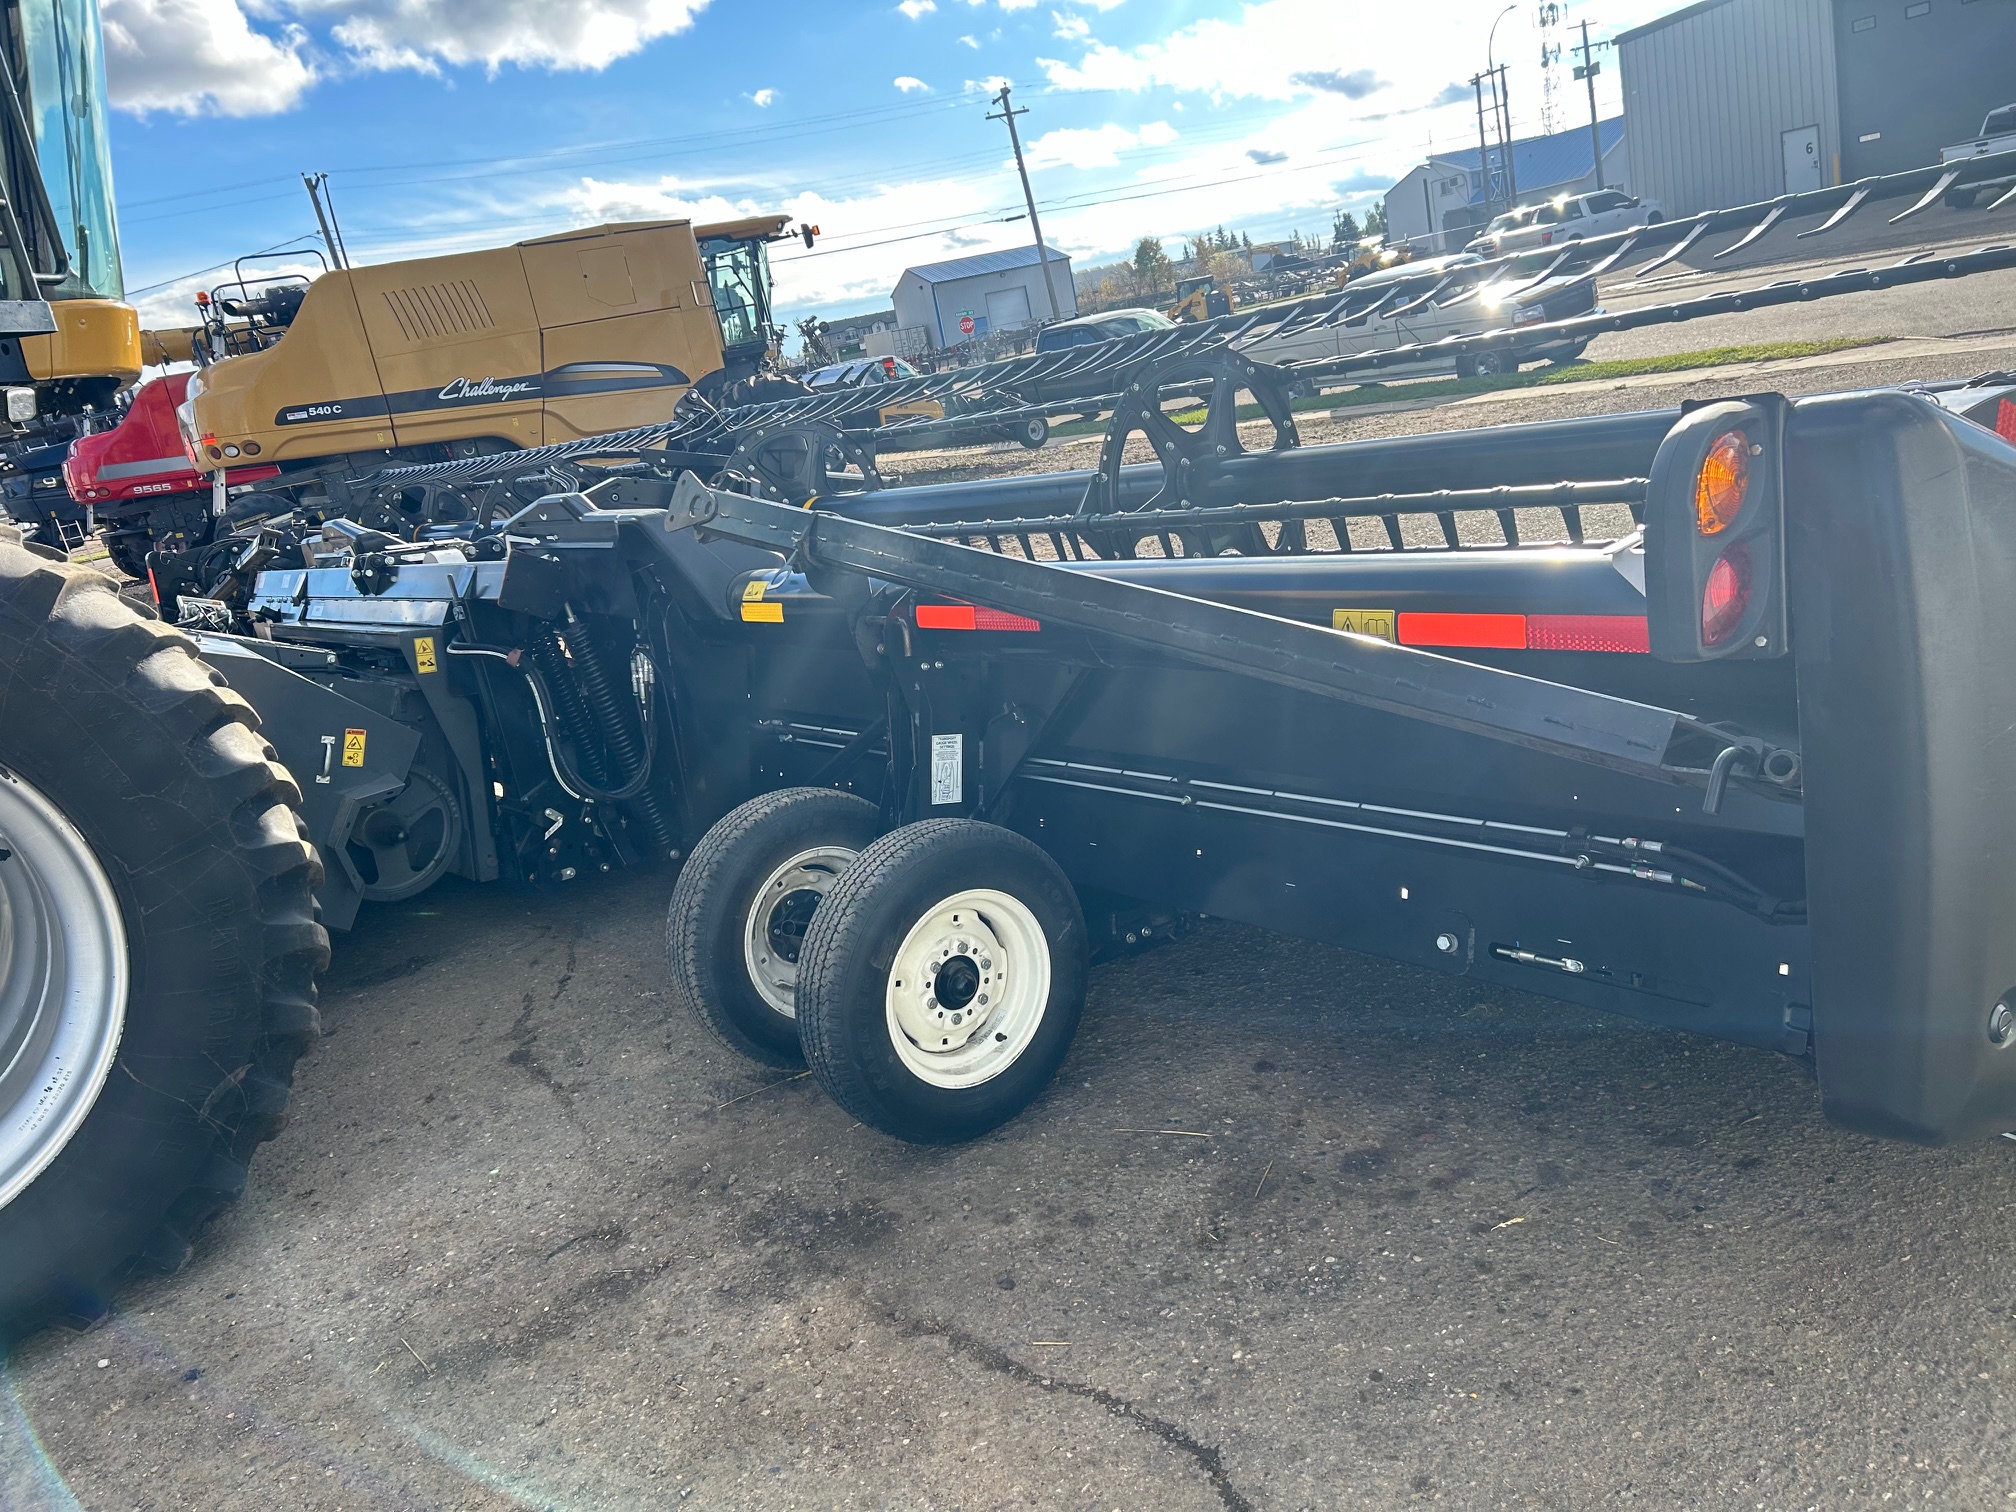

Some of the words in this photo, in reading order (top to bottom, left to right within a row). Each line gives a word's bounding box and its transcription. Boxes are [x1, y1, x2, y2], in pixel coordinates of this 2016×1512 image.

[1805, 142, 1814, 154] 6
[960, 321, 974, 330] STOP
[438, 376, 541, 401] Challenger
[308, 406, 331, 416] 540
[332, 405, 342, 414] C
[133, 483, 171, 495] 9565
